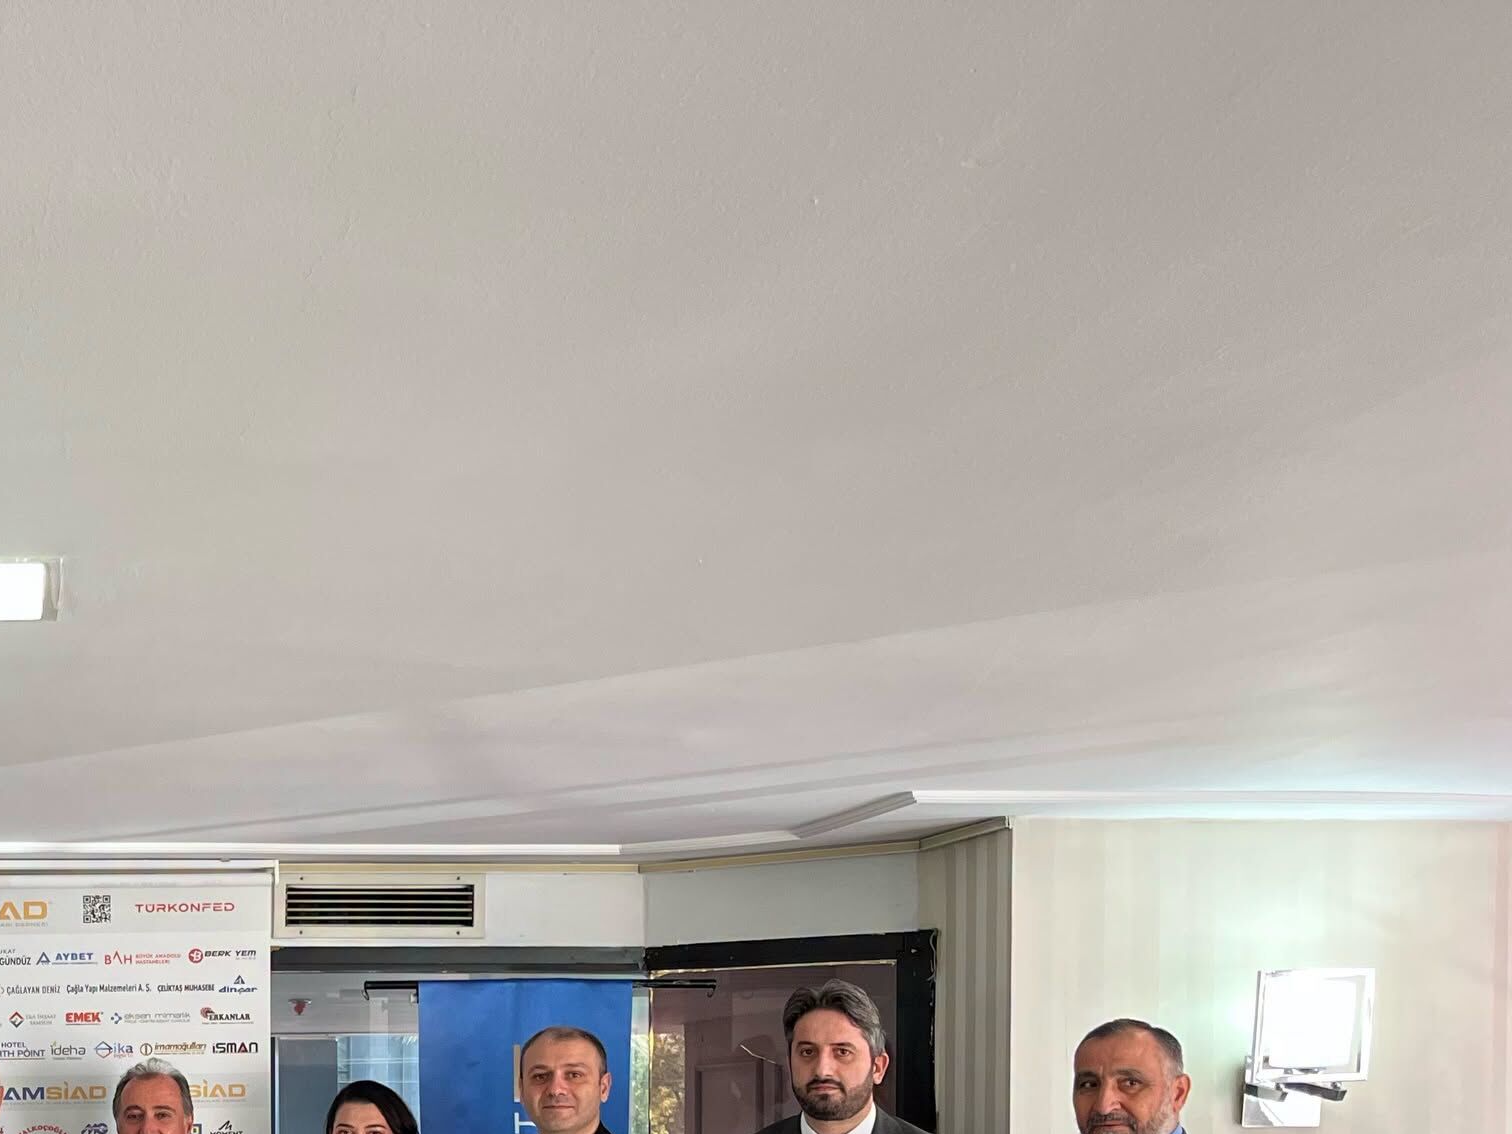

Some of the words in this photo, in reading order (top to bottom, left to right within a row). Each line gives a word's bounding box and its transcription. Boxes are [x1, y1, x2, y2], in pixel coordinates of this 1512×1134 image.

[135, 903, 235, 913] TÜRKONFED
[0, 955, 31, 966] GÜNDÜZ
[7, 985, 39, 995] ÇAĞLAYAN
[42, 985, 60, 993] DENİZ
[67, 985, 83, 994] Çağla
[99, 984, 137, 992] Malzemeleri
[66, 1012, 100, 1023] EMEK
[209, 1013, 250, 1021] ERKANLAR
[4, 1082, 106, 1100] AMSİAD
